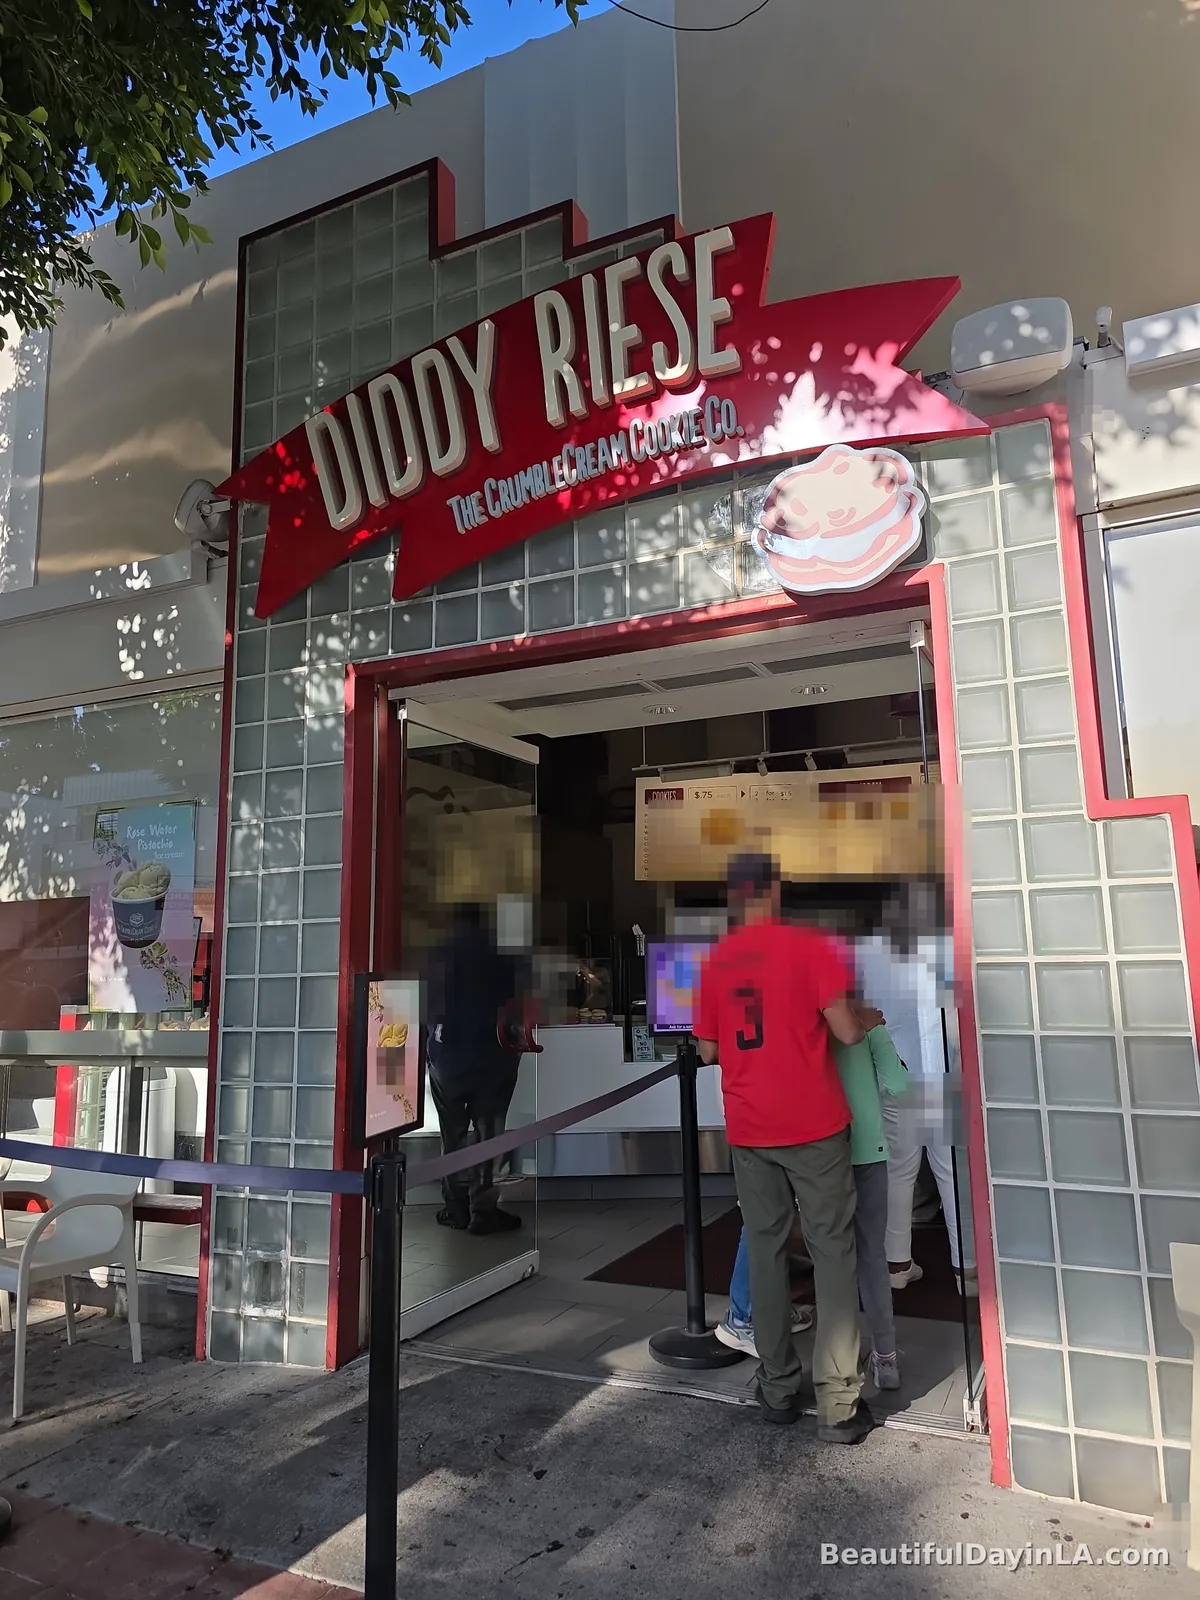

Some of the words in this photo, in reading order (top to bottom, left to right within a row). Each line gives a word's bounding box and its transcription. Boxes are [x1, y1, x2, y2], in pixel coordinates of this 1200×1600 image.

[305, 319, 501, 532] DIDDY
[534, 227, 742, 429] RIESE
[447, 490, 489, 535] THE
[629, 407, 706, 463] COOKIE
[704, 395, 745, 441] CO.
[694, 791, 713, 799] $.75
[126, 825, 146, 839] Rose
[149, 822, 178, 836] Water
[137, 838, 174, 851] Pistachio
